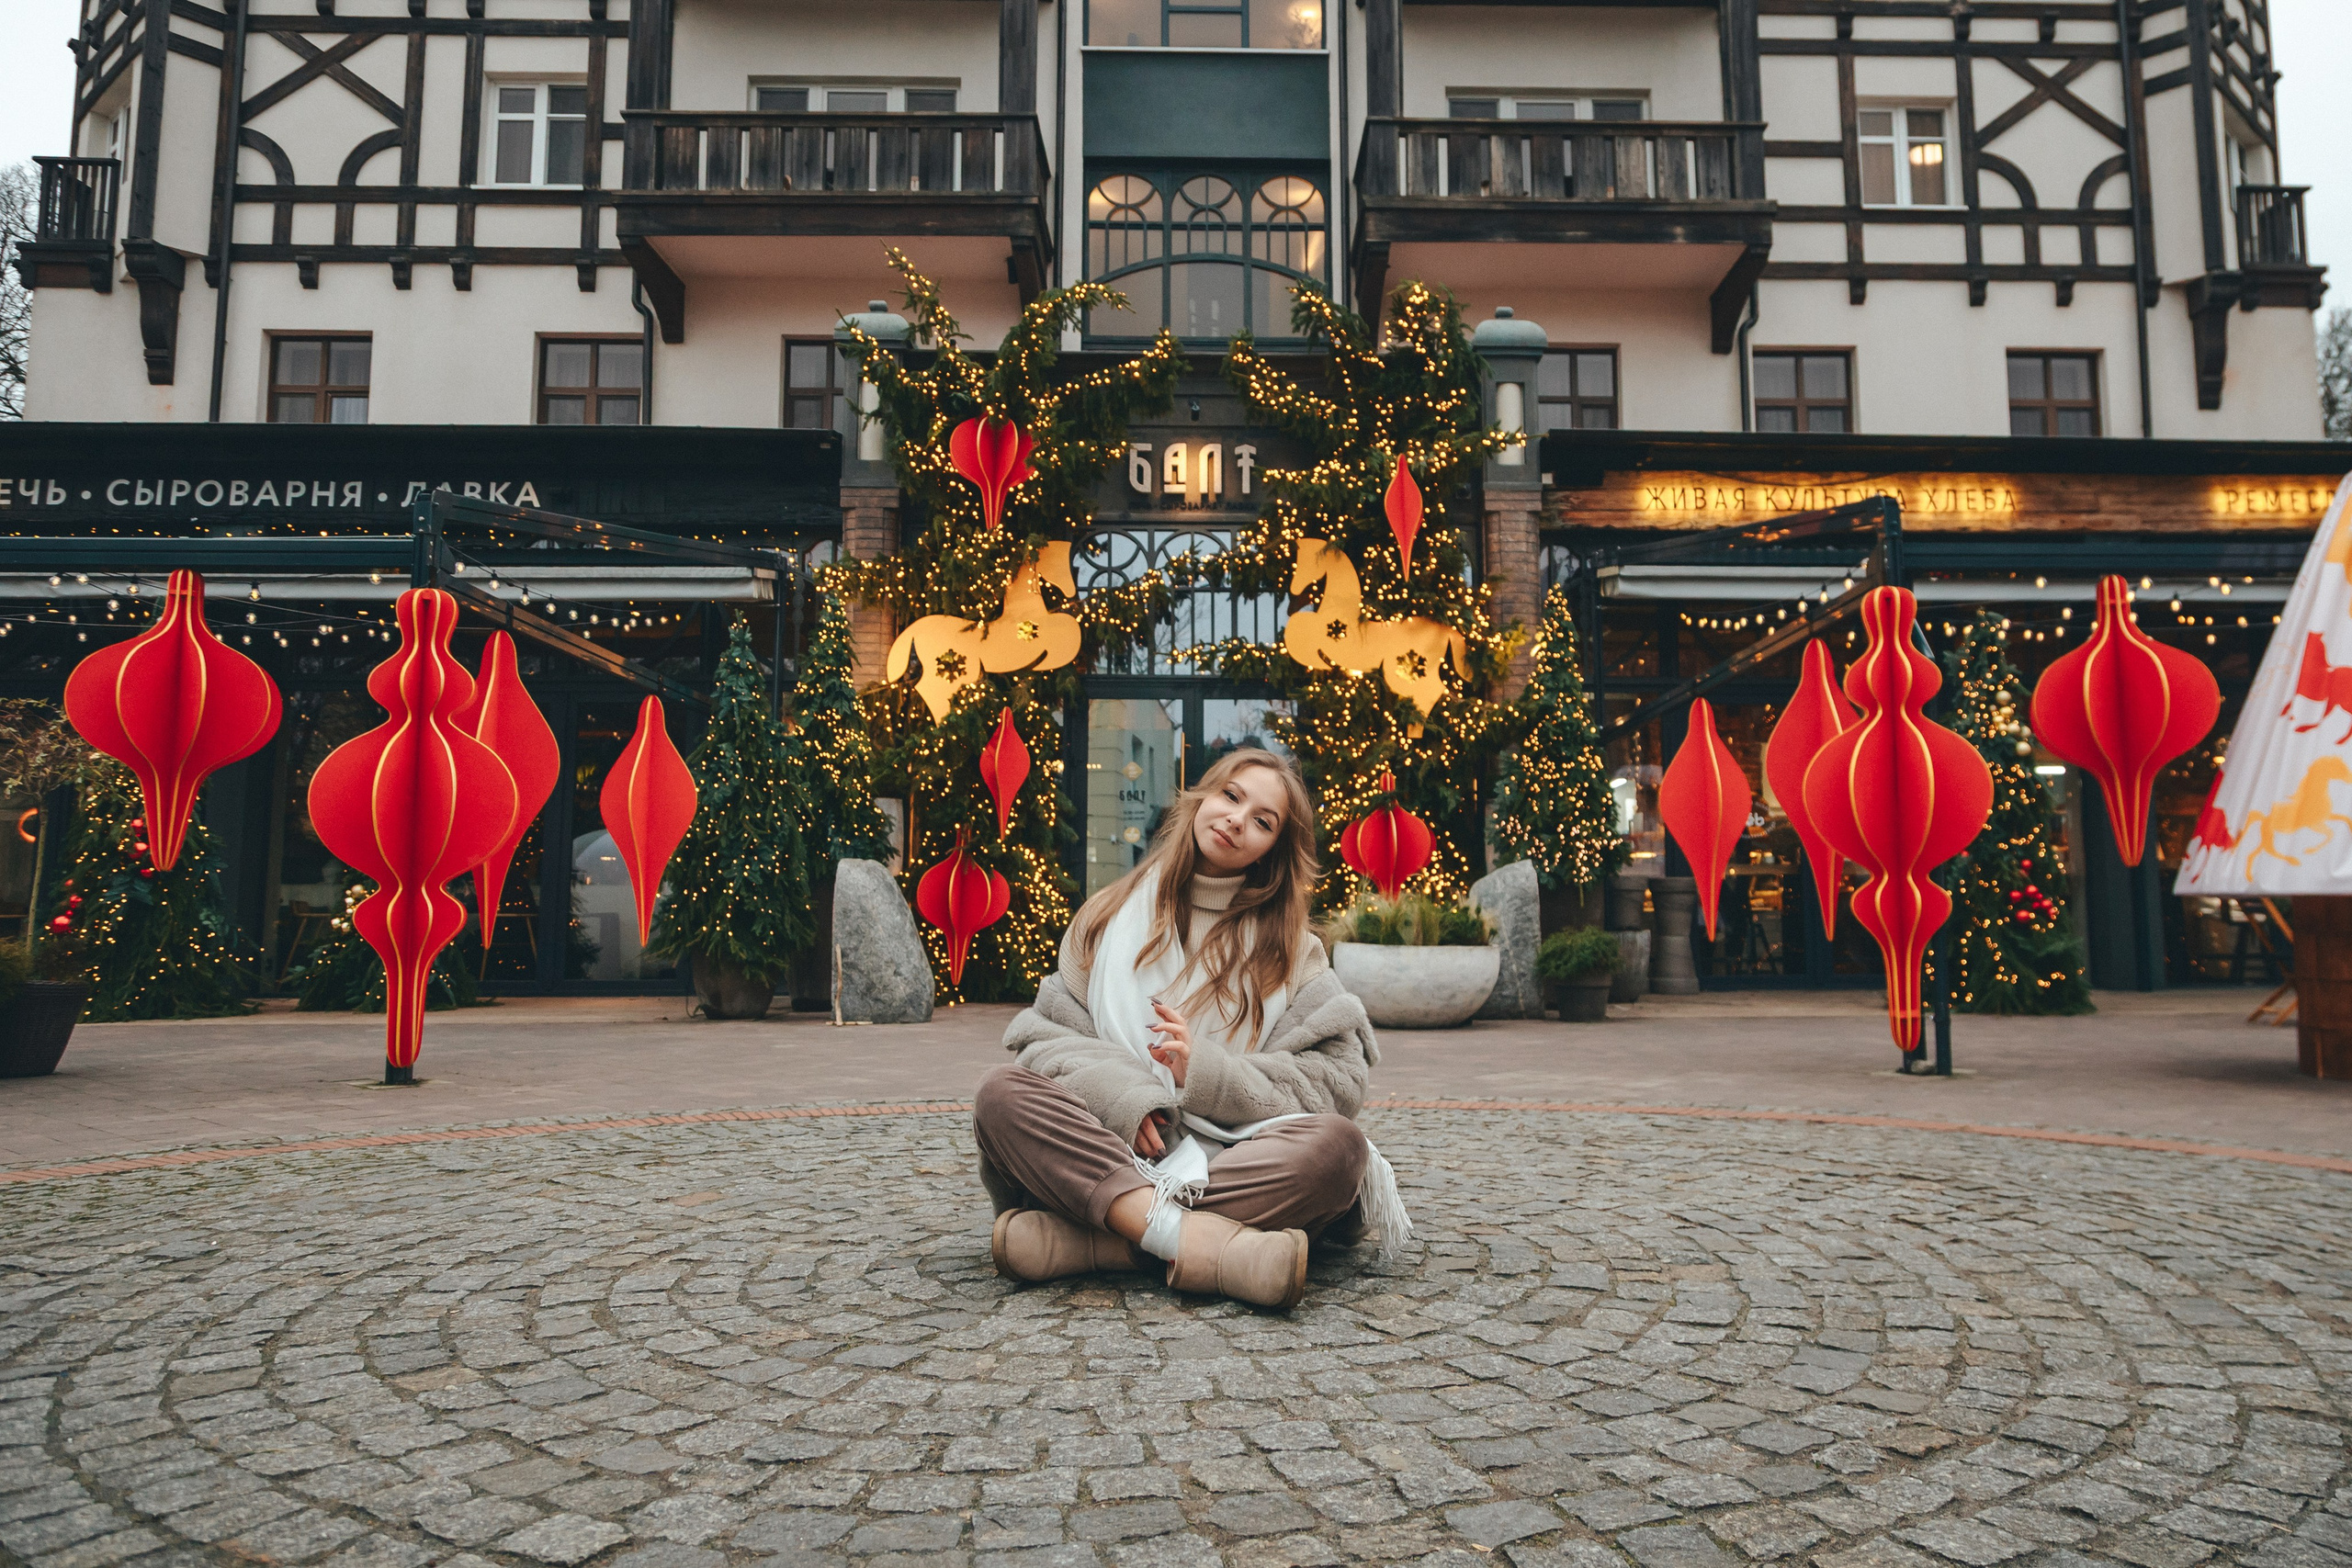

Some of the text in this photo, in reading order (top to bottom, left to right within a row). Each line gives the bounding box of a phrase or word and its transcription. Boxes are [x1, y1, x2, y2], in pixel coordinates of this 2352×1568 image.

[1129, 442, 1257, 494] БАЛТ
[107, 479, 363, 507] СЫРОВАРНЯ
[1645, 487, 1746, 510] ЖИВАЯ
[1924, 488, 2016, 511] ХЛЕБА
